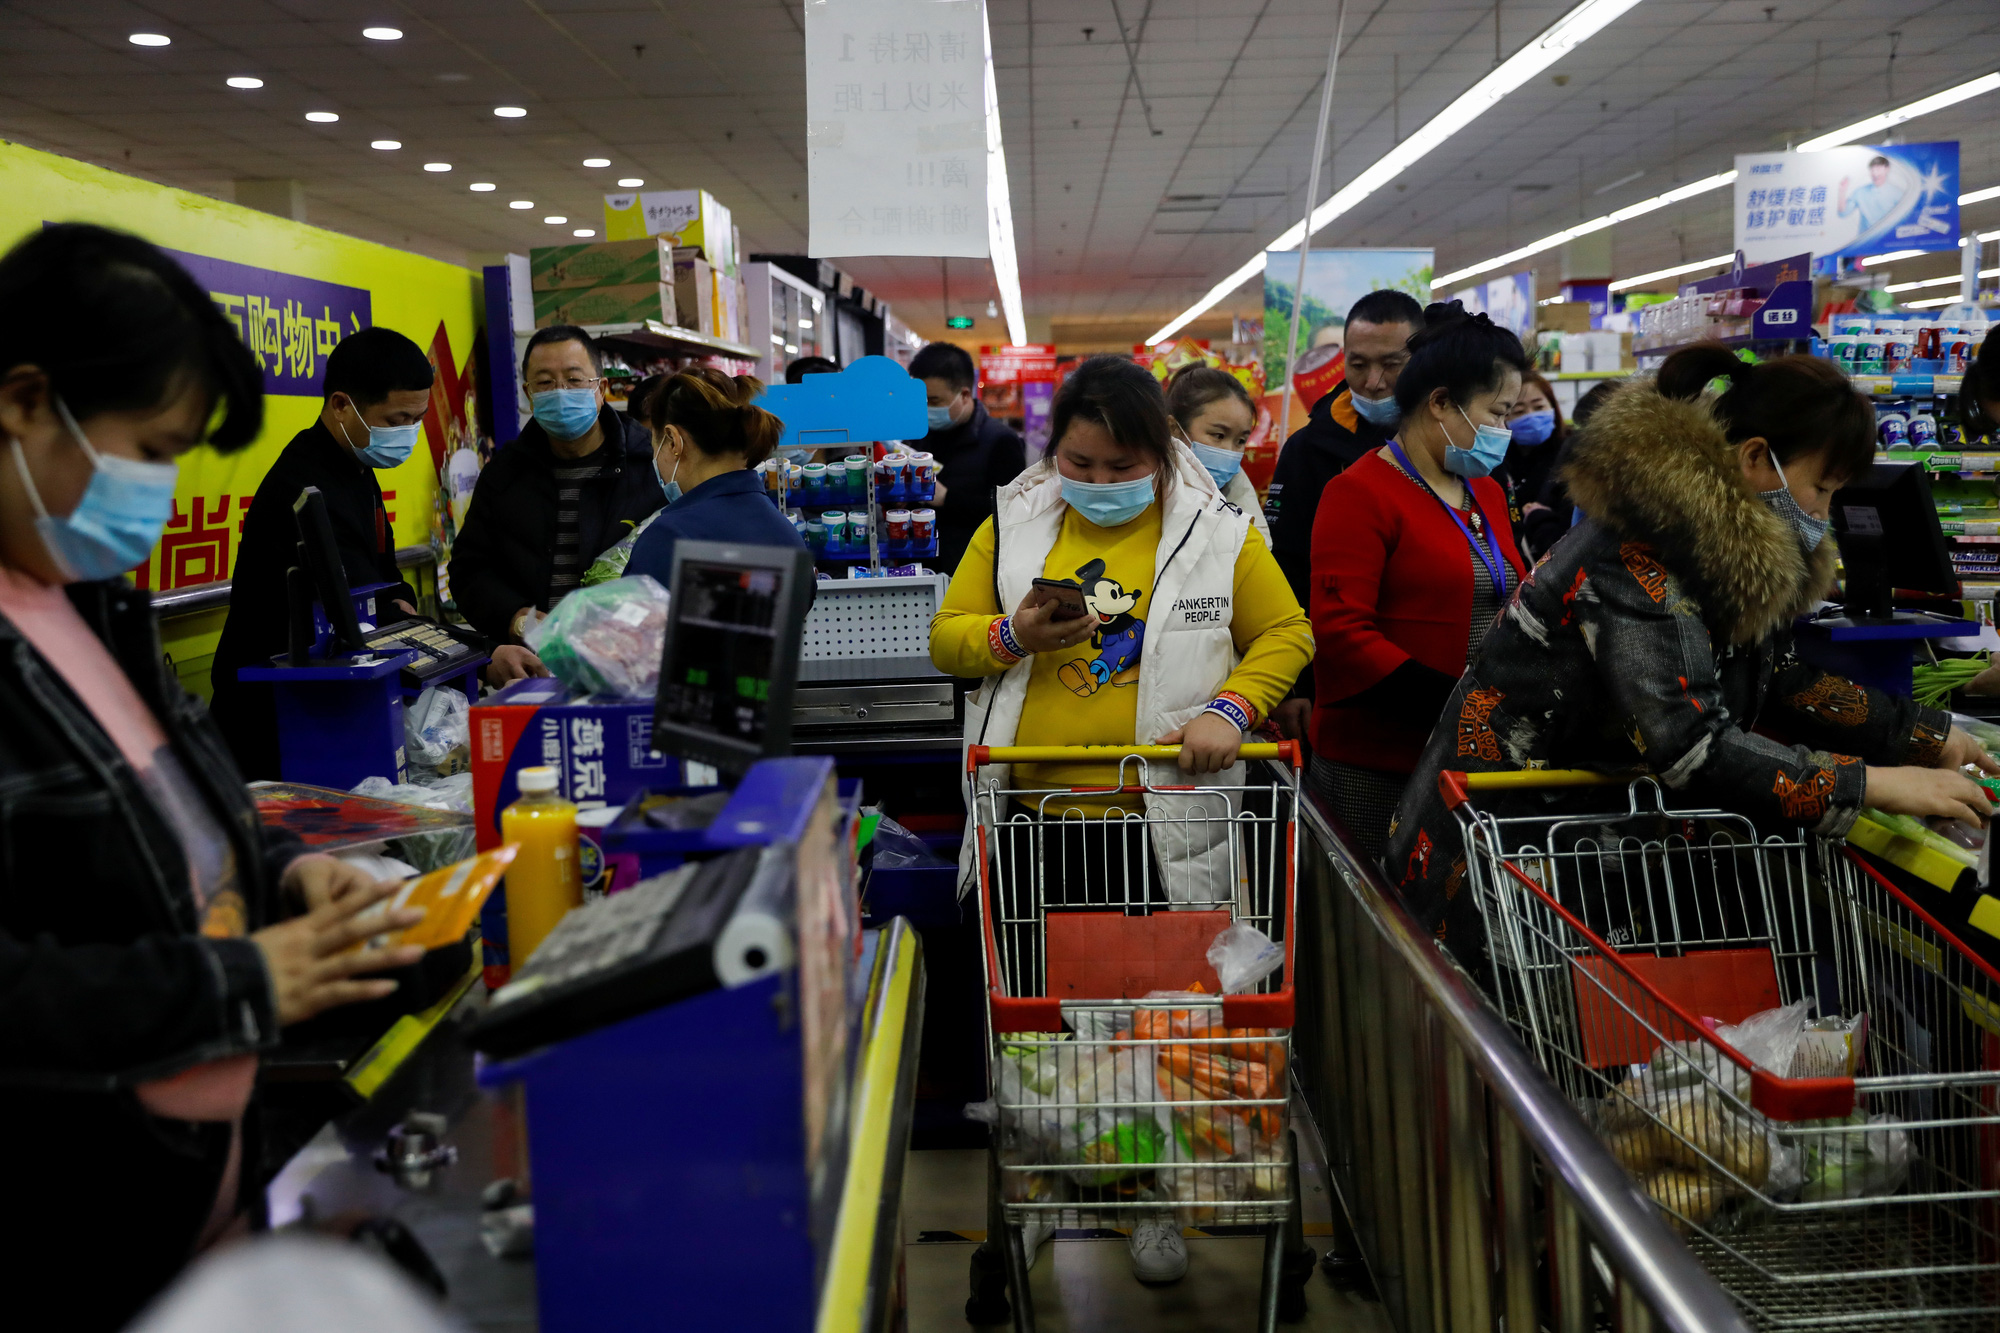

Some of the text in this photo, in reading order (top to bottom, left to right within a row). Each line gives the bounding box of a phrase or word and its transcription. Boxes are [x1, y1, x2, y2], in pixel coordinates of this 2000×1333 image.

[1746, 185, 1828, 209] 舒缓疼痛
[1745, 207, 1828, 230] 修护敏感
[209, 290, 361, 379] 购物中
[1954, 553, 1998, 562] SNICKERS
[1958, 565, 2000, 573] SNICKERS
[1184, 610, 1221, 623] PEOPLE
[1222, 703, 1249, 733] BUR
